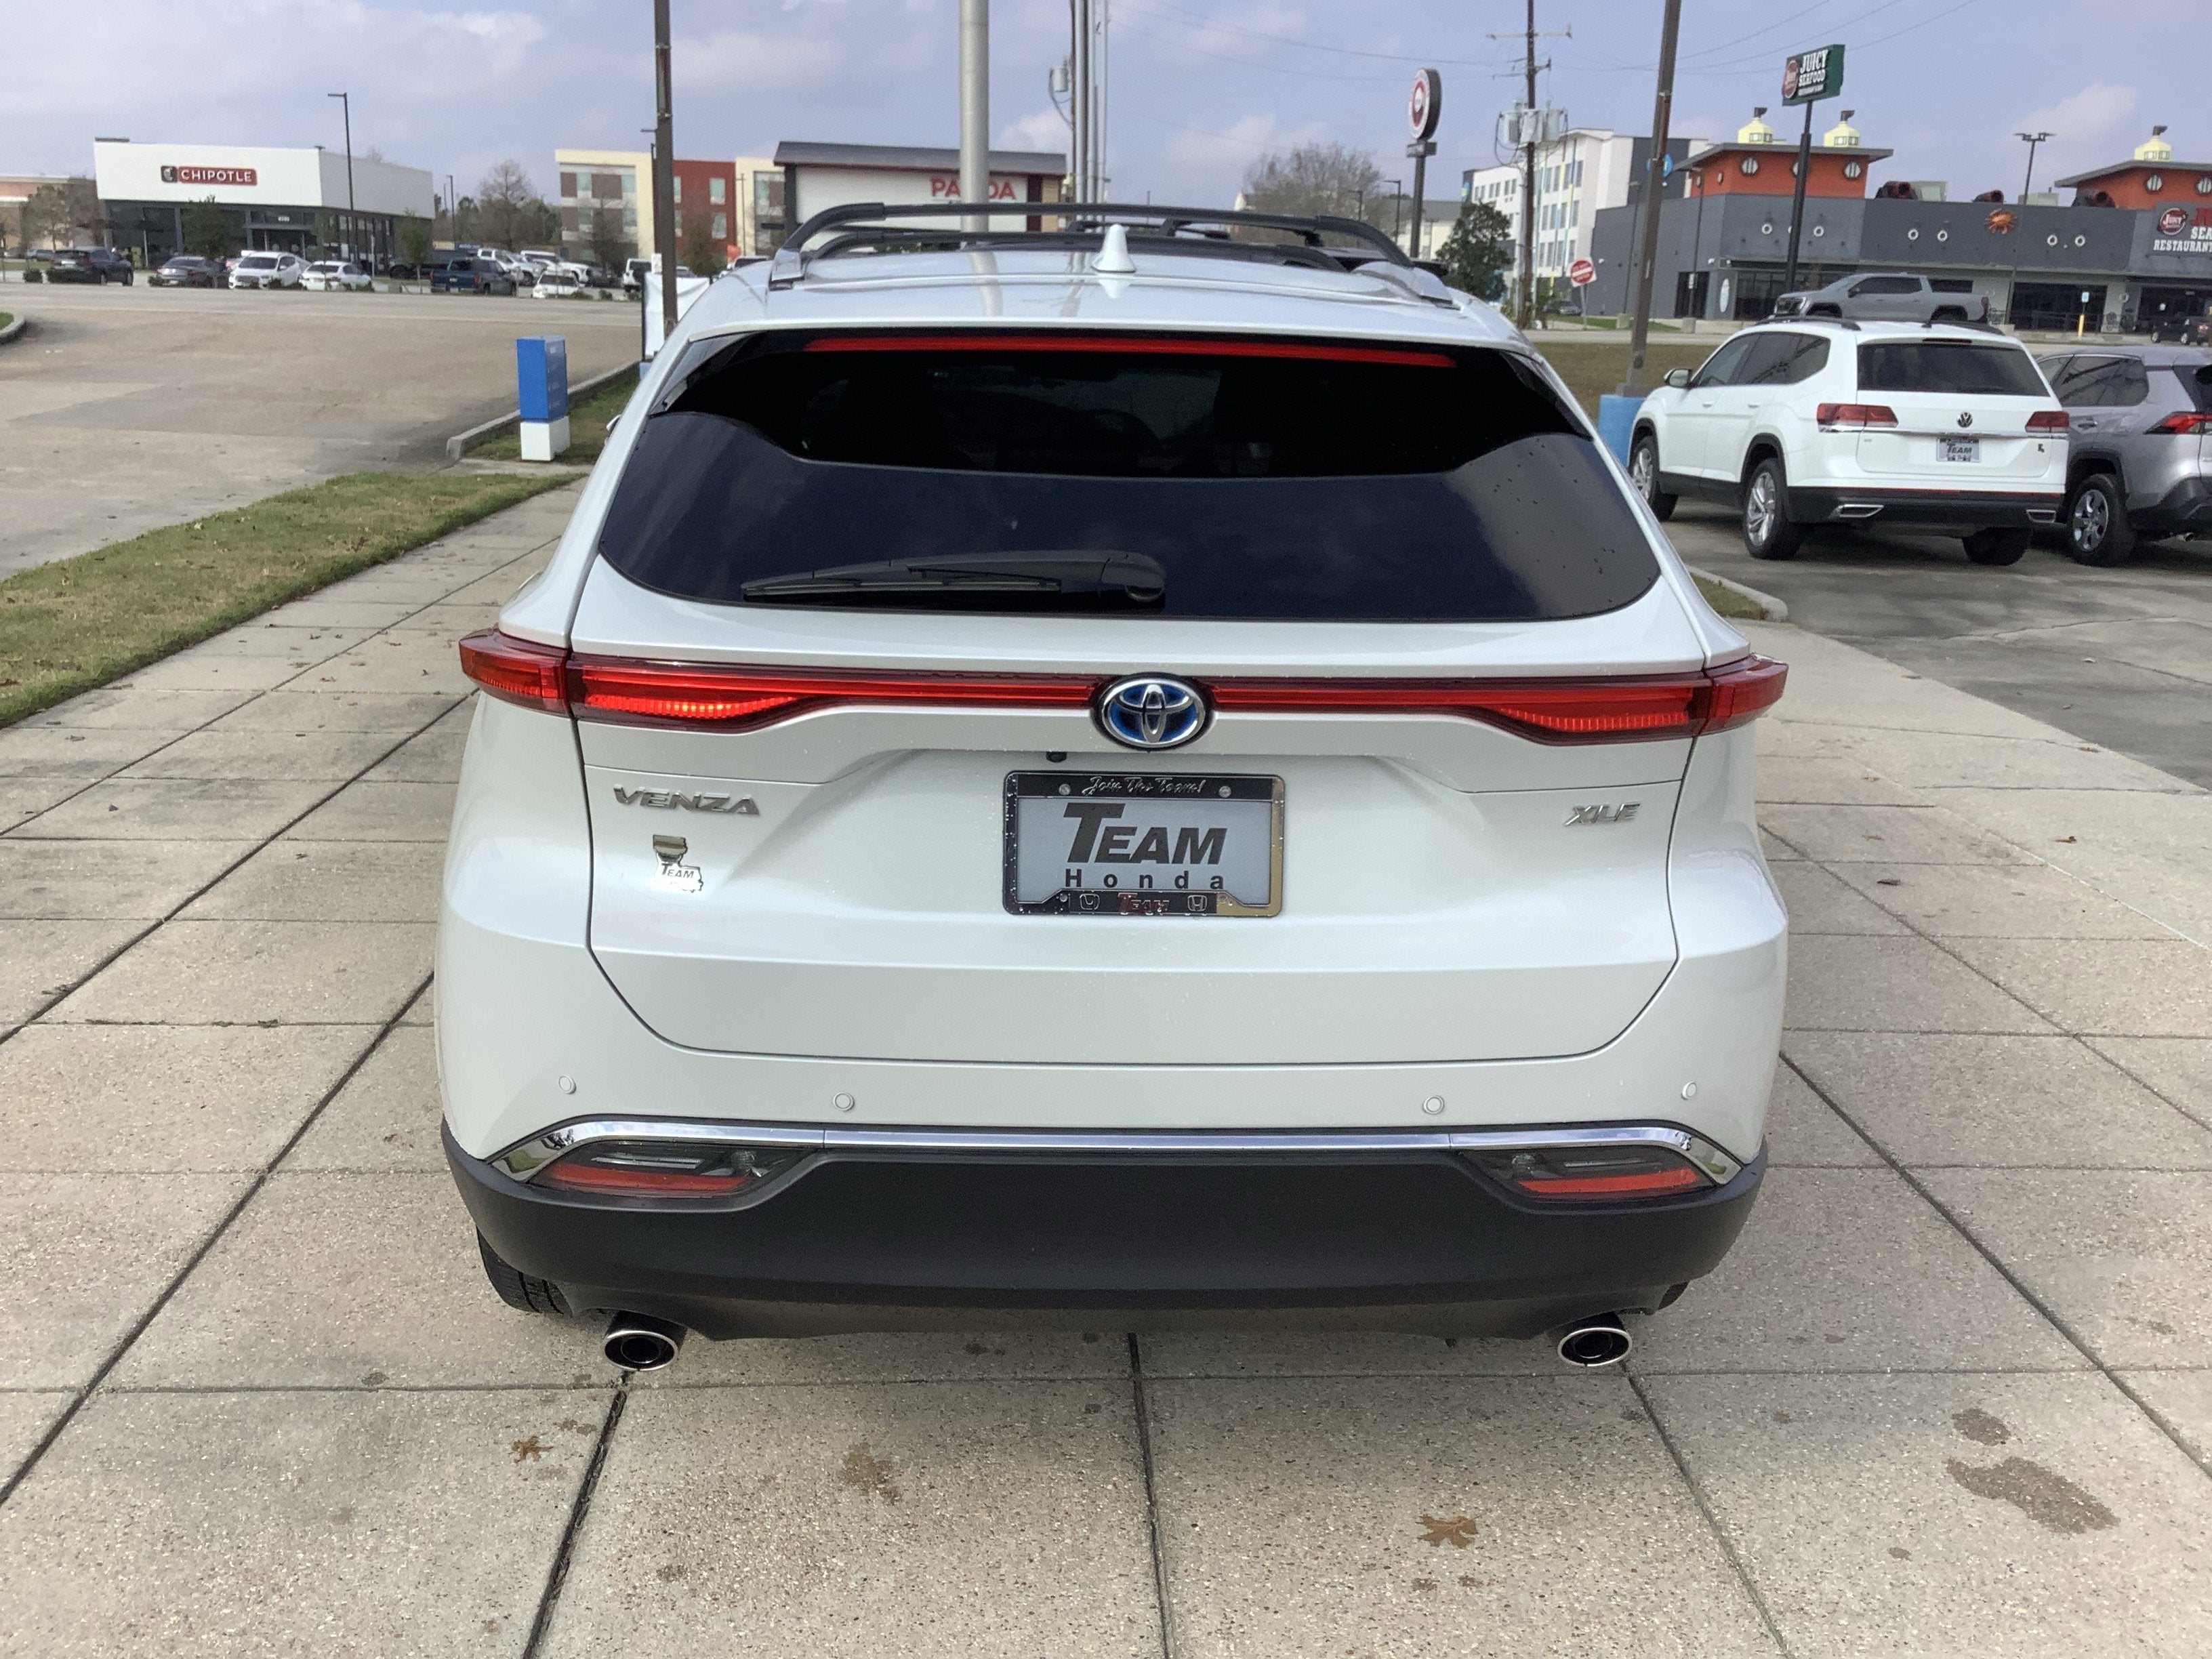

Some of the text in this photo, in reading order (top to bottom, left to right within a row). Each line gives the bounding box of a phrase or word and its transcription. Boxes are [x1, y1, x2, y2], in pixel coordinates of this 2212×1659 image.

[1800, 49, 1828, 74] JUICY
[1798, 68, 1826, 87] SEAFOOD
[181, 169, 253, 182] CHIPOTLE
[930, 178, 1016, 200] PADA
[1946, 443, 1972, 454] TEAM
[1082, 776, 1122, 796] Join
[613, 784, 760, 815] VENZA
[1564, 802, 1641, 827] XLE
[1063, 802, 1228, 865] TEAM
[661, 863, 695, 879] TEAM
[1065, 868, 1225, 890] Honda
[1118, 892, 1170, 914] TEAM
